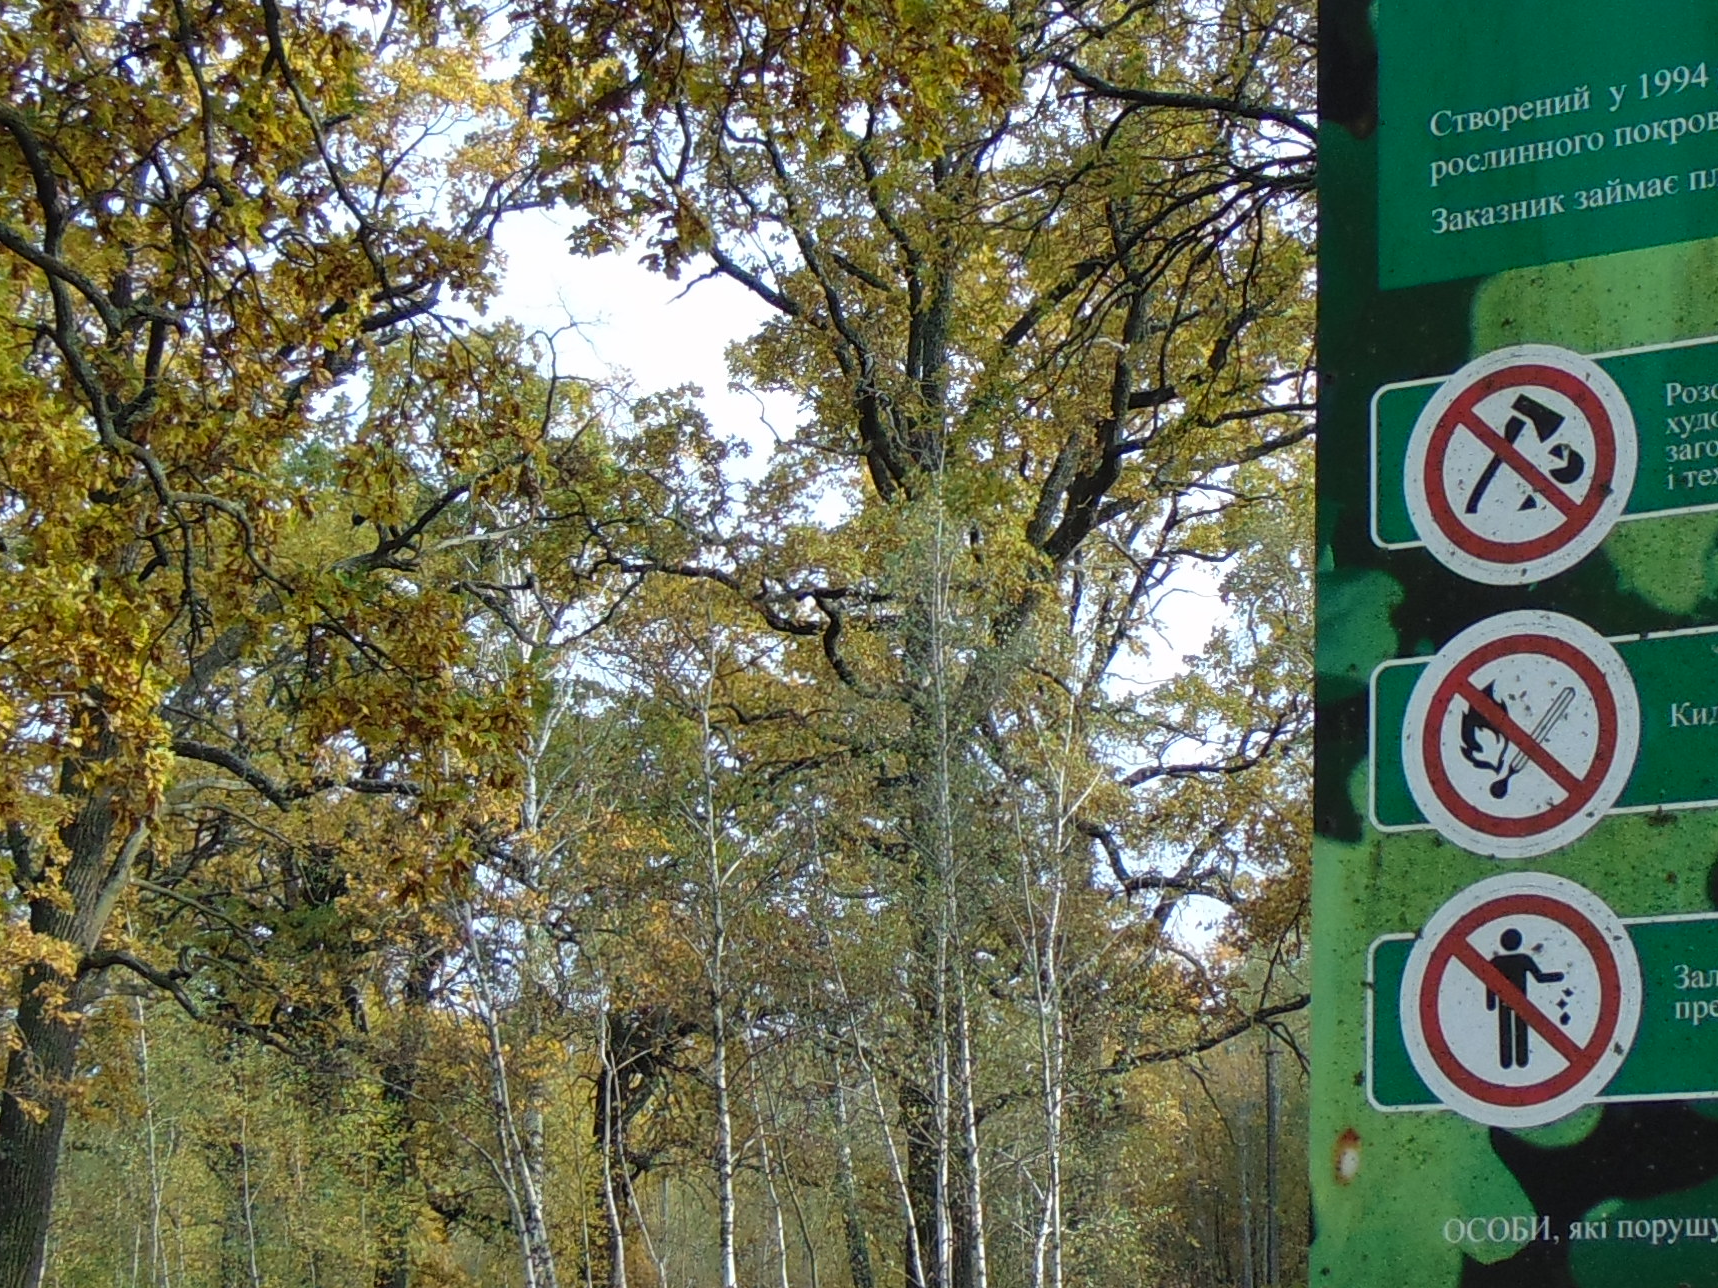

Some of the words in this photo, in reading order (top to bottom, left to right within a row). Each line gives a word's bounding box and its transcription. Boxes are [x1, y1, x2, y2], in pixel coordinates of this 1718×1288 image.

[1429, 85, 1591, 137] Створений
[1609, 83, 1626, 110] у
[1639, 62, 1709, 101] 1994
[1429, 130, 1605, 185] рослинного
[1431, 192, 1565, 235] Заказник
[1573, 173, 1680, 210] займає
[1666, 466, 1675, 491] і
[1443, 1215, 1561, 1246] ОСОБИ,
[1568, 1212, 1608, 1239] які
